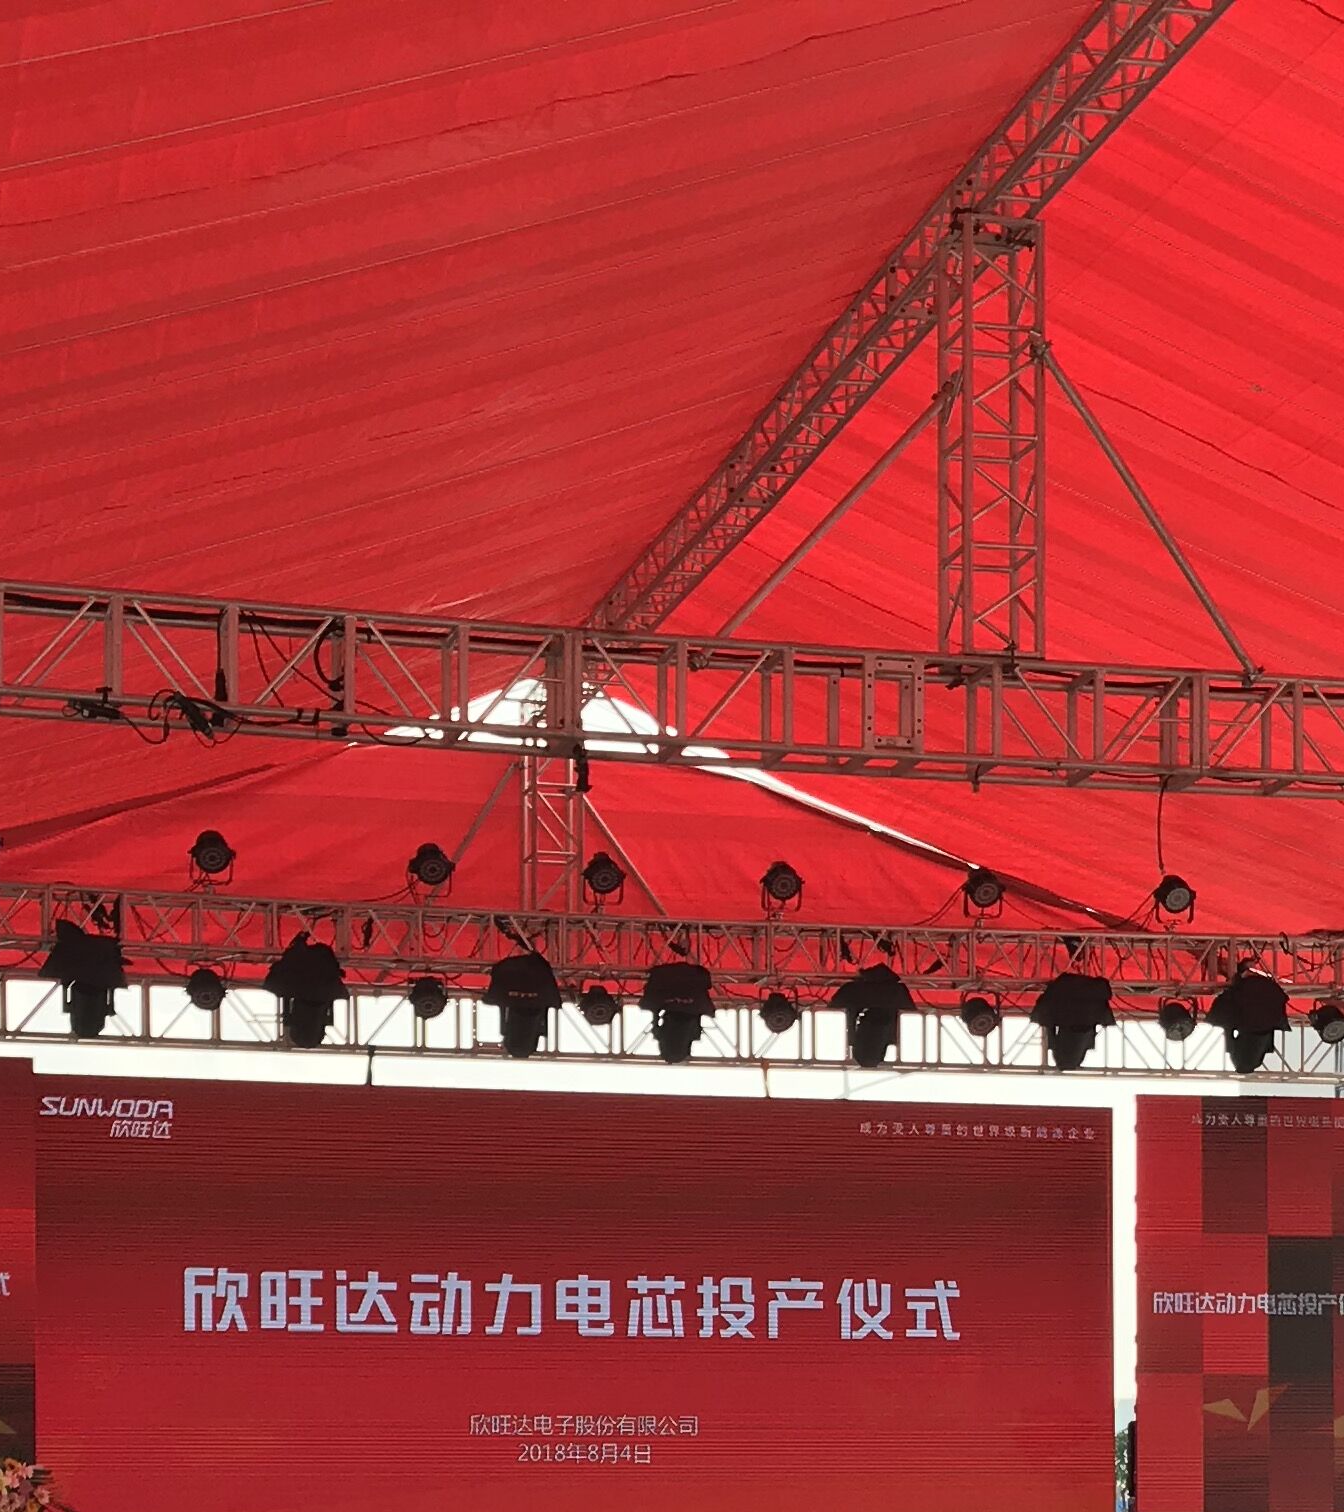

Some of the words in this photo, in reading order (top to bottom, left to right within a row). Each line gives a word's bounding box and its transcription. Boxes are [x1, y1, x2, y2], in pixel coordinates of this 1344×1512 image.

[39, 1096, 174, 1119] SUNWODA
[110, 1120, 173, 1139] 欣旺达
[183, 1266, 962, 1341] 欣旺达动力电芯投产仪式
[469, 1414, 699, 1437] 欣旺达电子股份有限公司
[517, 1443, 652, 1464] 2018年8月4日
